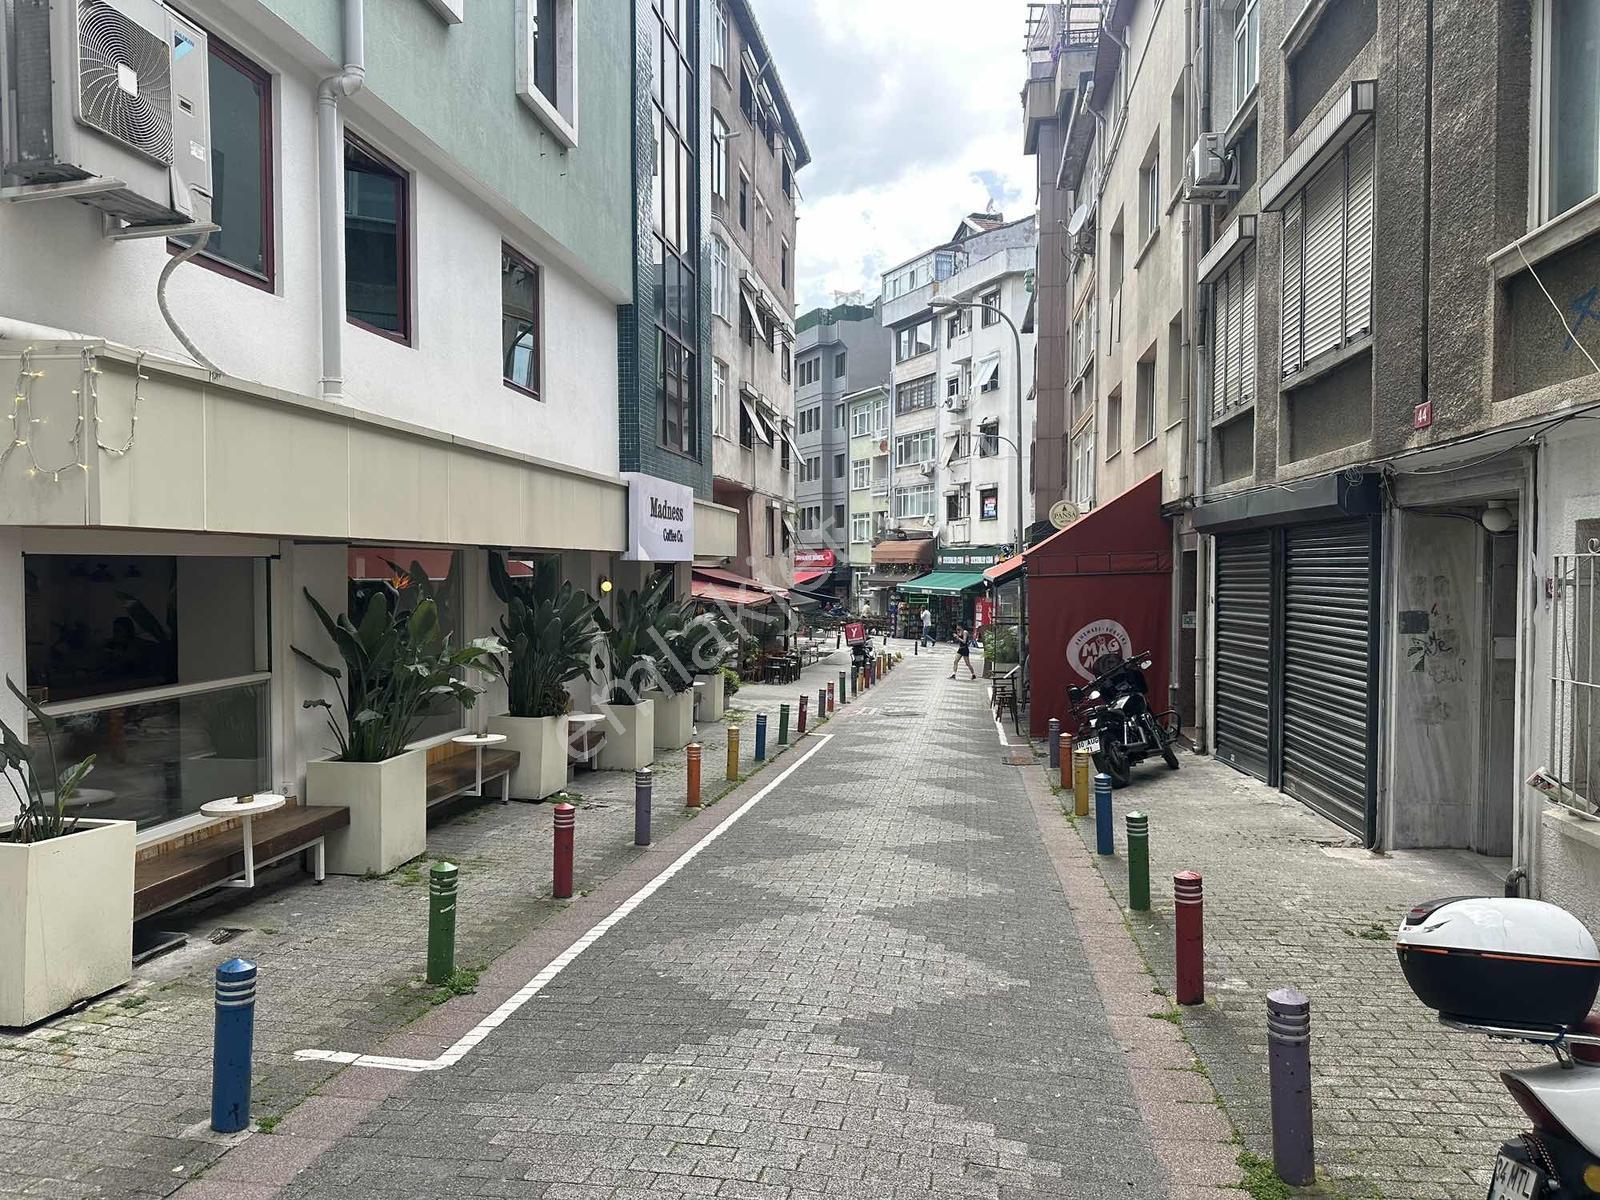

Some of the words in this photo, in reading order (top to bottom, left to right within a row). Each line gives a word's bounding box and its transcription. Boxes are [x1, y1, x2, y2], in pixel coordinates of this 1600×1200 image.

[1417, 406, 1427, 423] 44
[650, 497, 684, 522] Madness
[663, 528, 677, 542] Coffee
[1082, 638, 1120, 657] MAG
[1507, 1163, 1531, 1199] MTL
